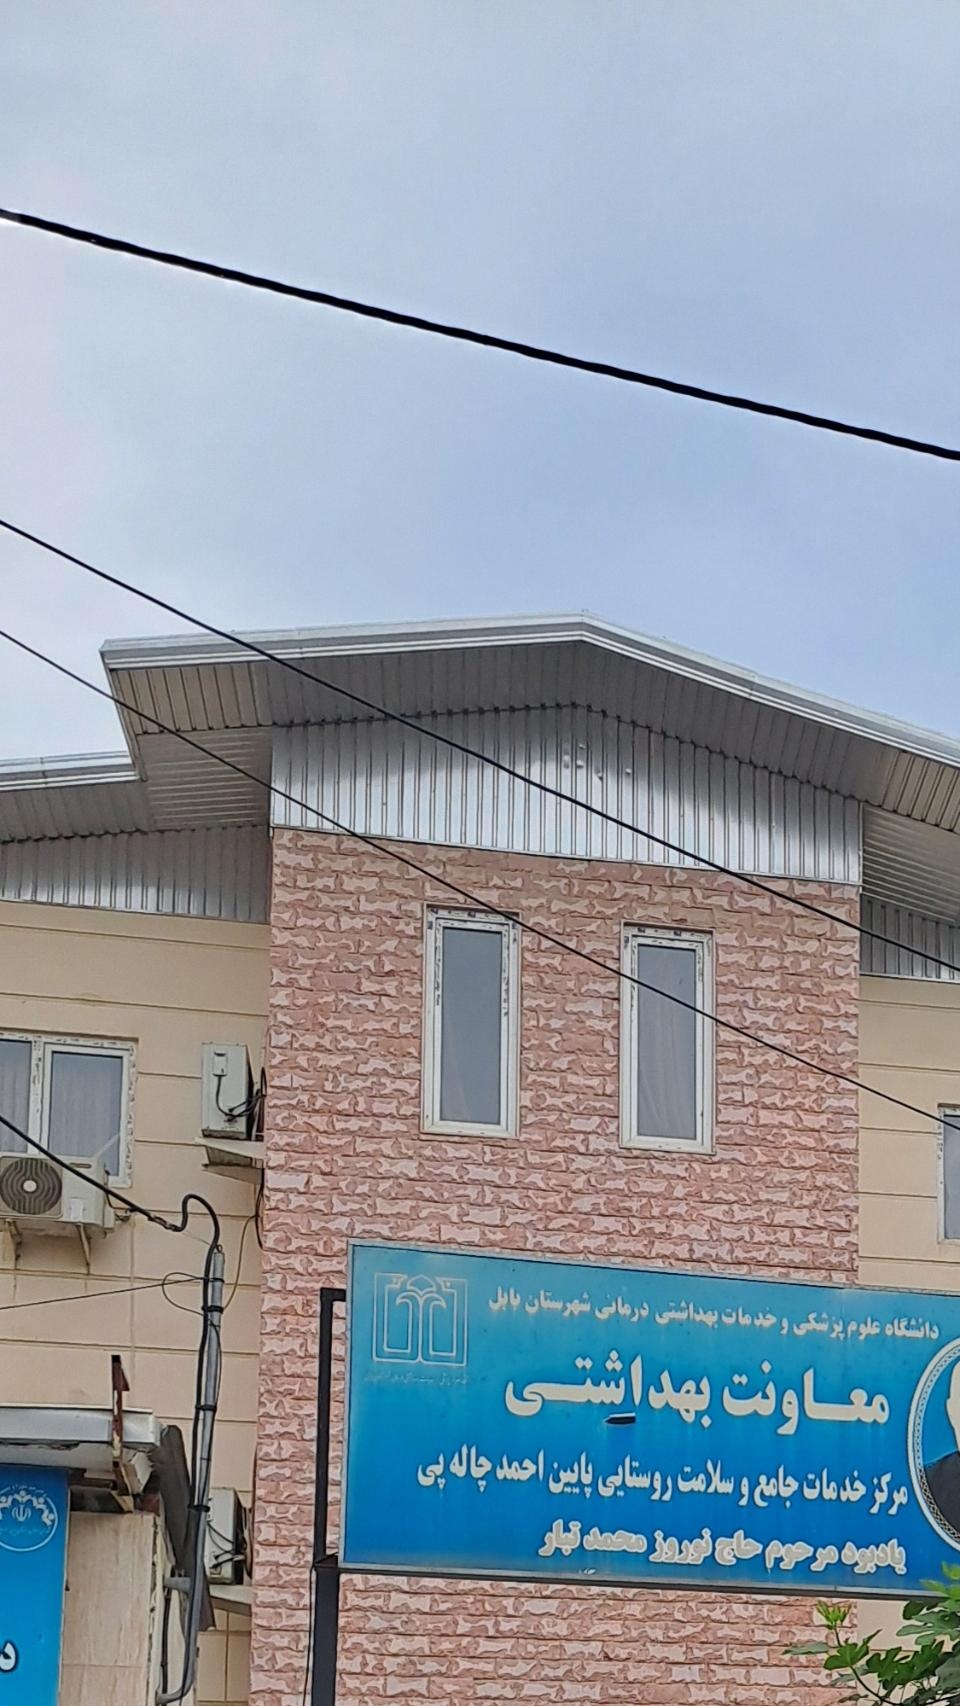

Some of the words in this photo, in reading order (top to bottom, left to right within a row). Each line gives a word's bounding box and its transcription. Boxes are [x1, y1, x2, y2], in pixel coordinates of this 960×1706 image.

[489, 1286, 521, 1312] بابل
[525, 1289, 591, 1317] شهرستان
[595, 1293, 649, 1322] درمانی
[655, 1299, 718, 1328] بهداشتی
[721, 1306, 777, 1327] خدمات
[780, 1317, 788, 1335] و
[793, 1312, 845, 1340] پزشکی
[848, 1316, 880, 1340] علوم
[885, 1316, 939, 1339] دانشگاه
[505, 1349, 713, 1429] بهداشتی
[722, 1359, 890, 1436] معاونت
[417, 1453, 446, 1490] پی
[450, 1443, 492, 1493] چاله
[496, 1449, 544, 1482] احمد
[549, 1451, 593, 1498] پایین
[598, 1454, 672, 1501] روستایی
[677, 1459, 734, 1494] سلامت
[738, 1476, 749, 1506] و
[753, 1464, 799, 1509] جامع
[802, 1468, 867, 1502] خدمات
[869, 1472, 908, 1515] مرکز
[538, 1518, 581, 1557] تبار
[583, 1526, 647, 1553] محمد
[649, 1527, 712, 1565] نوروز
[715, 1529, 763, 1566] حاج
[765, 1540, 839, 1572] مرحوم
[841, 1538, 907, 1575] یادبود
